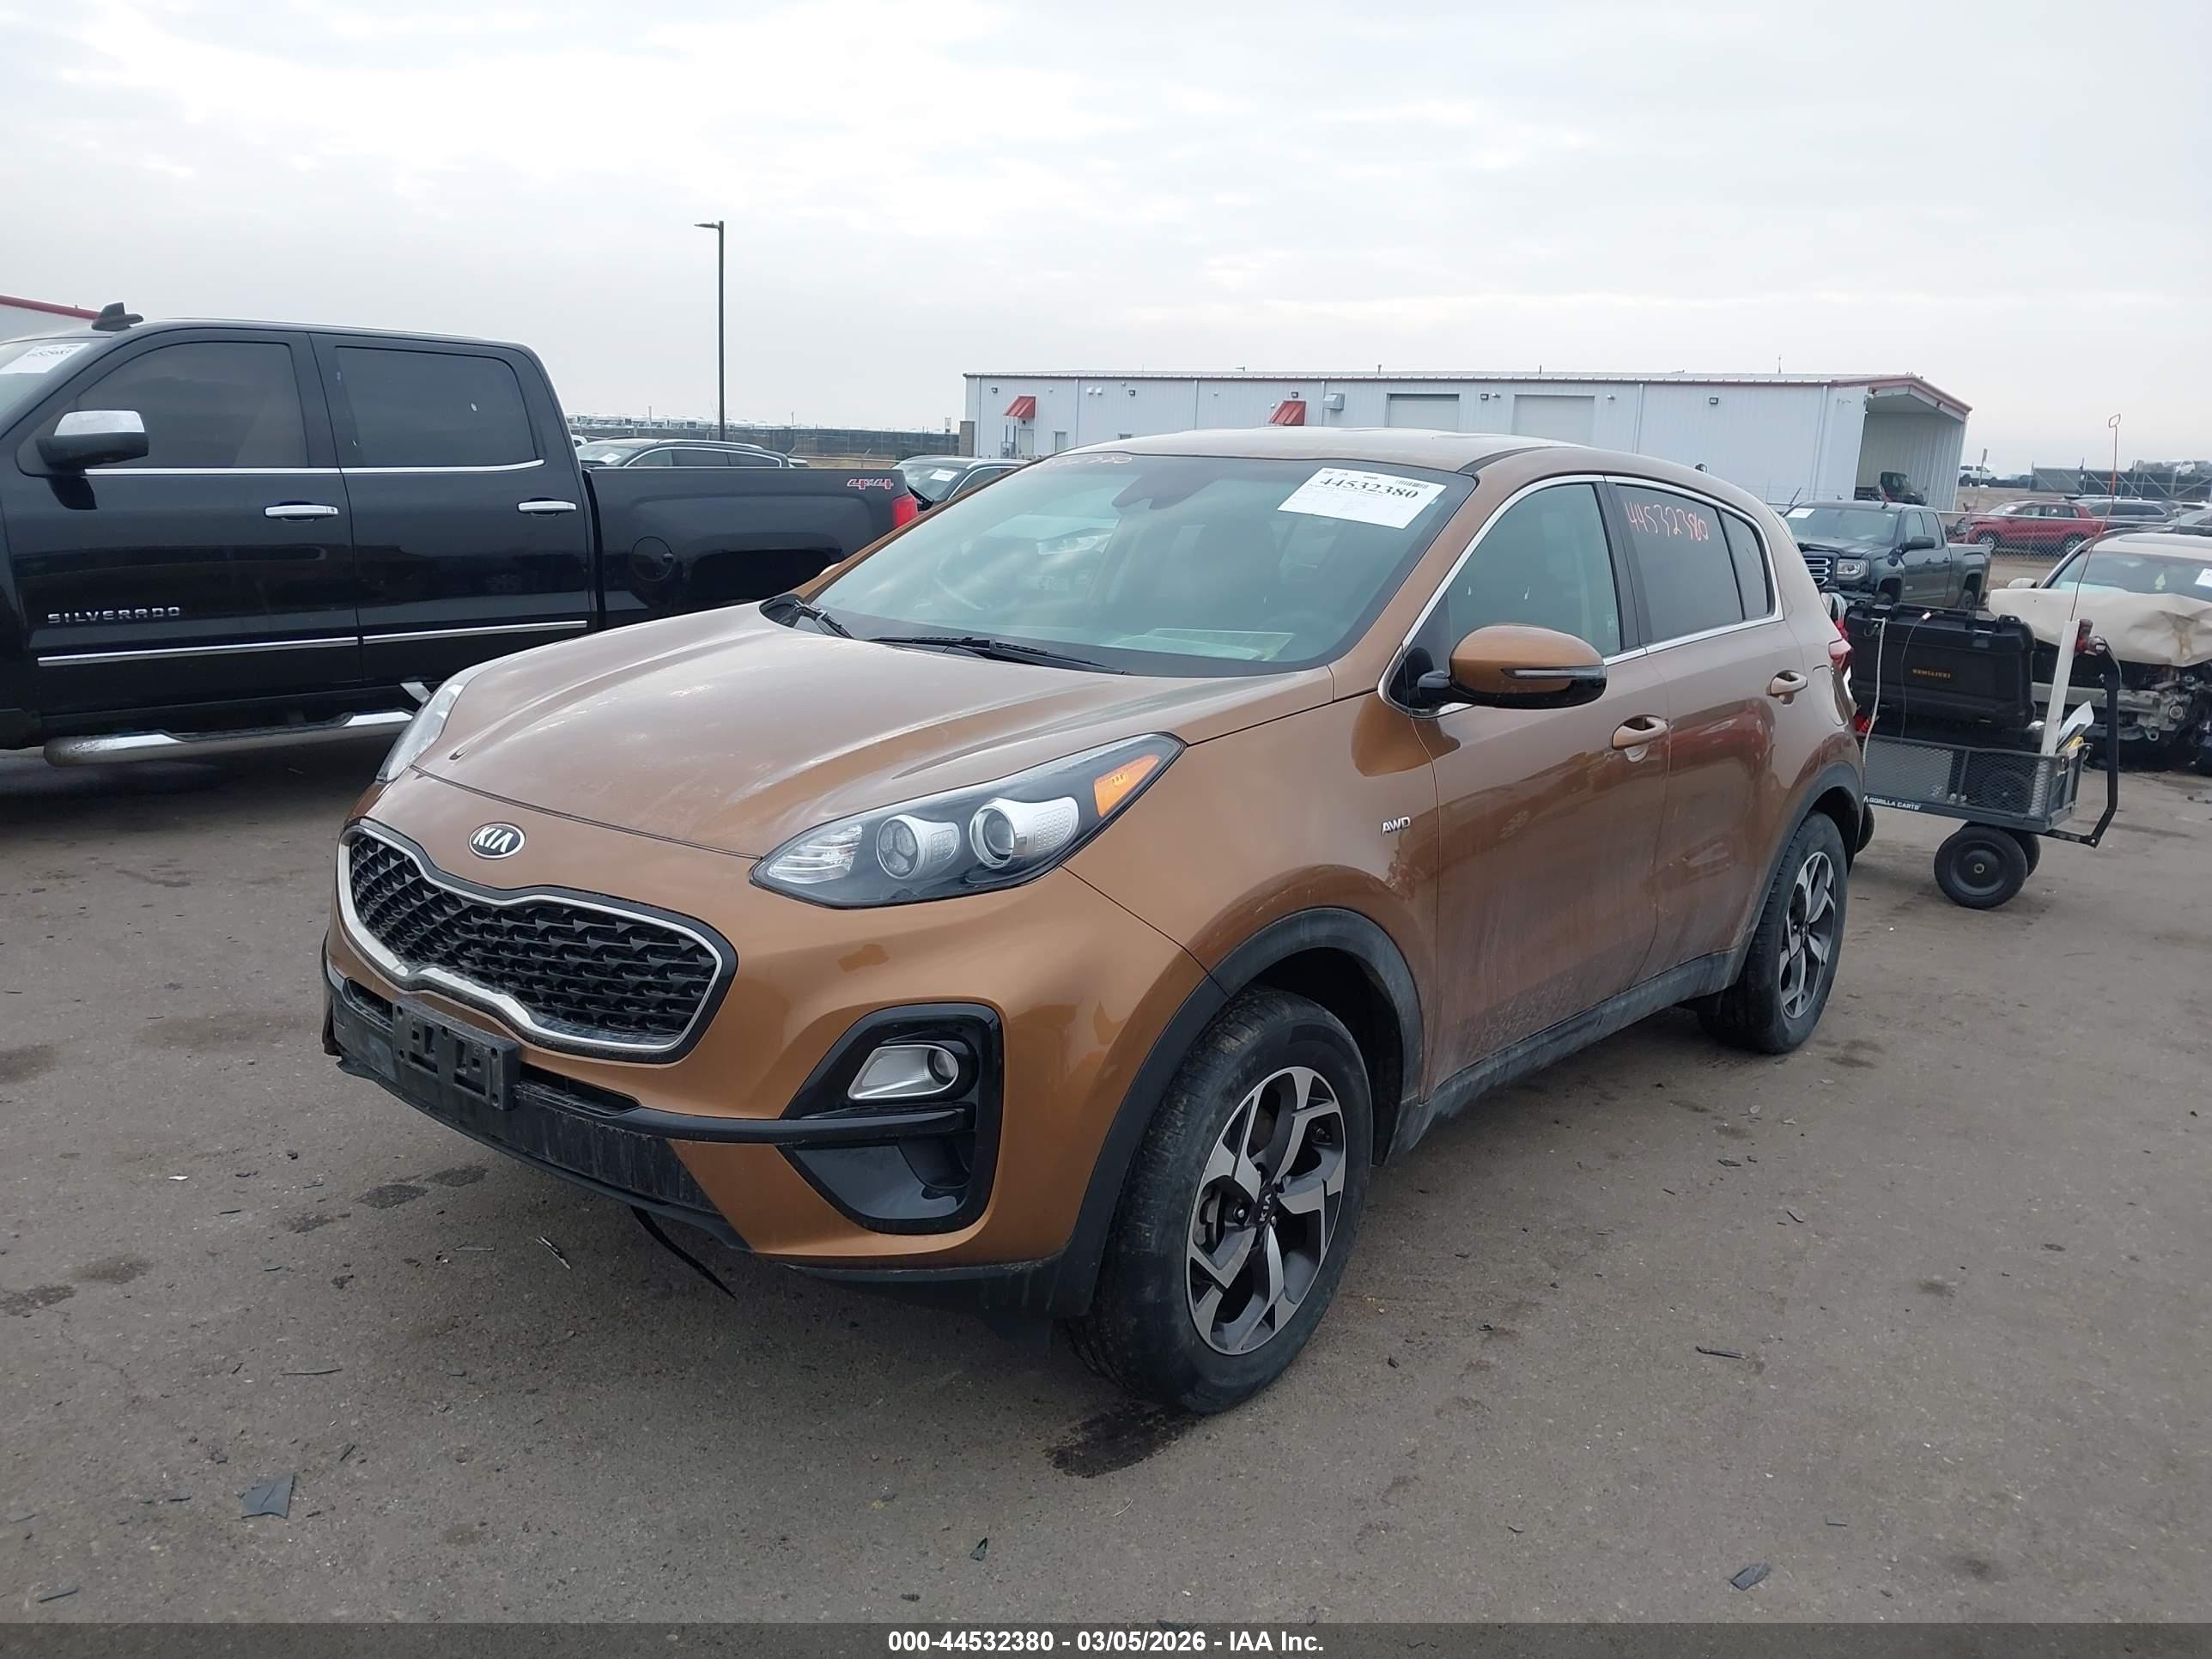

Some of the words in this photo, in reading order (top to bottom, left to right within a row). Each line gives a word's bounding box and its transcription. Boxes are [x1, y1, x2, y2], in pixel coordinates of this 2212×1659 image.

[1319, 477, 1419, 499] 44532380
[1624, 501, 1709, 541] 44532380
[47, 606, 180, 623] SILVERADO
[1869, 797, 1896, 807] GORILLA
[1382, 816, 1411, 836] AWD
[472, 826, 514, 853] KIA
[1259, 1194, 1272, 1222] KIA
